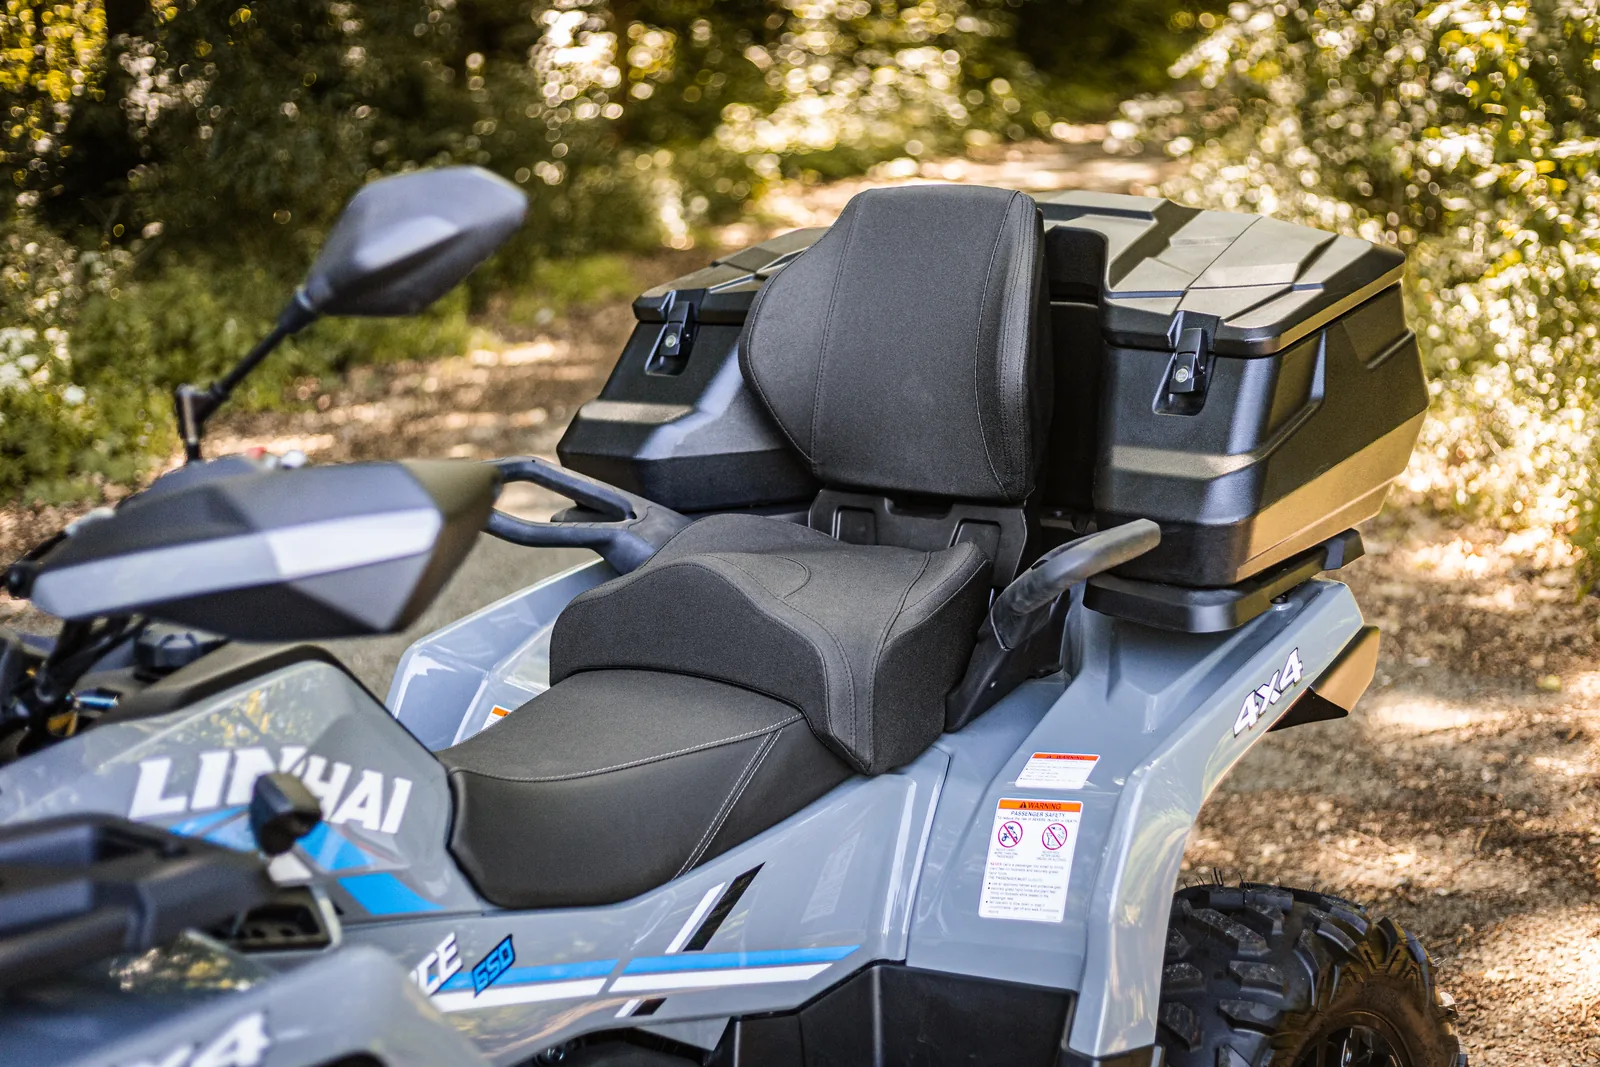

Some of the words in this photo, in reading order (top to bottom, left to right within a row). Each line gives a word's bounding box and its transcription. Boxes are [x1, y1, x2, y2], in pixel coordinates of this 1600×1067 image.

[128, 746, 412, 834] LINHAI
[1028, 801, 1062, 811] WARNING
[472, 936, 514, 995] 650
